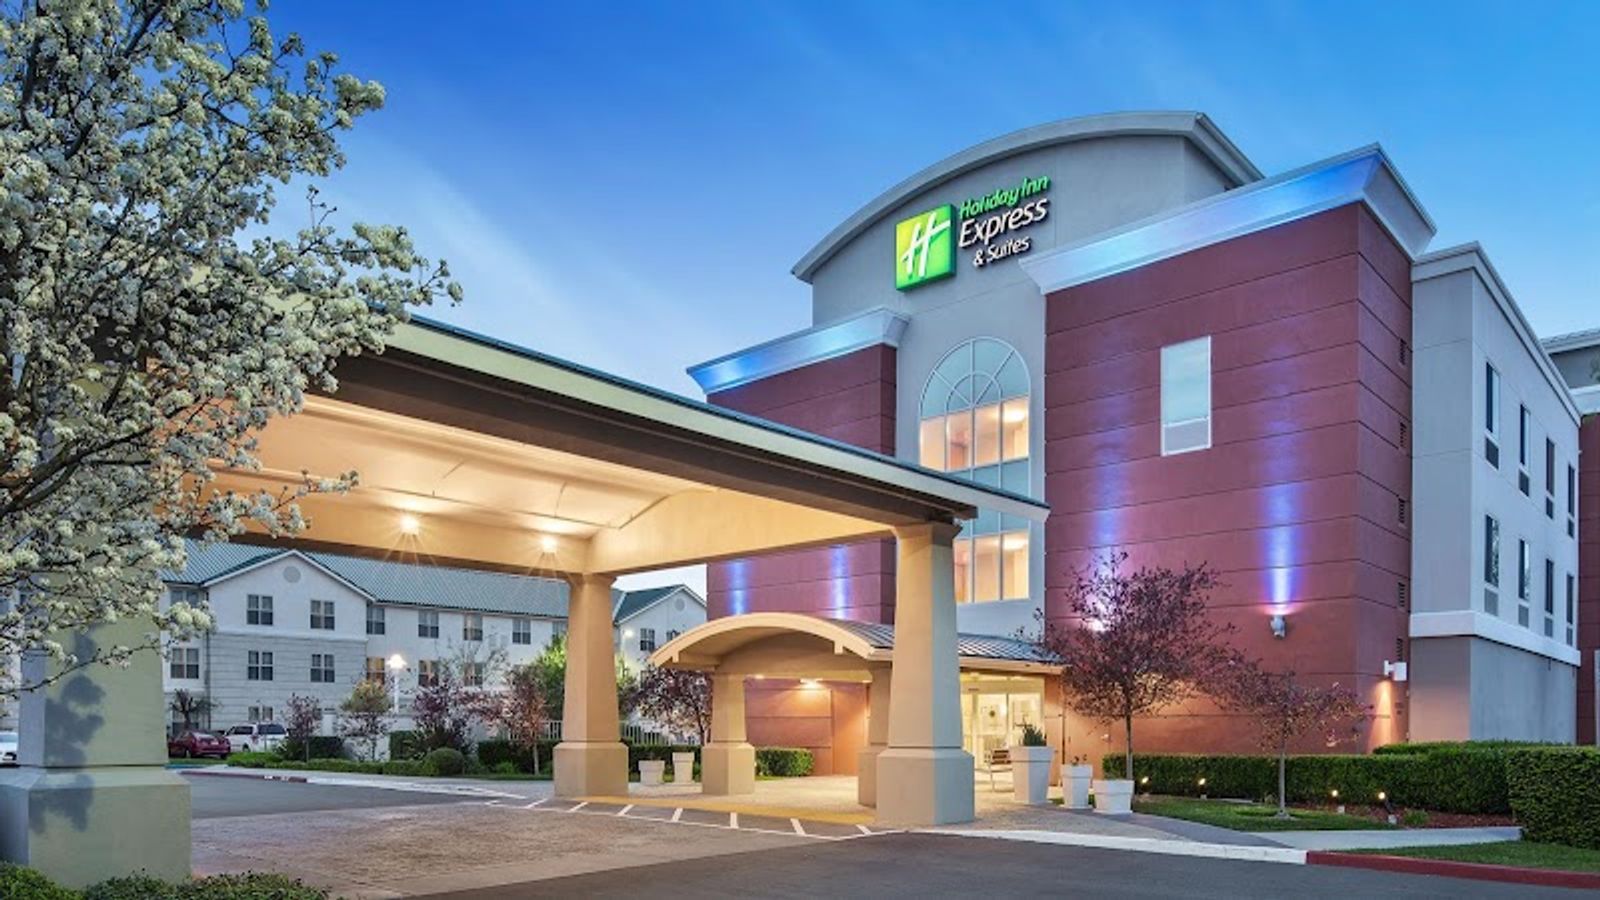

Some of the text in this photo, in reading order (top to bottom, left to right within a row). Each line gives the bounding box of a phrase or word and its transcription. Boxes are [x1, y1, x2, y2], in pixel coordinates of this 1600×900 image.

[959, 175, 1050, 219] Holiday Inn
[958, 198, 1049, 248] Express
[973, 235, 1031, 268] & Suites
